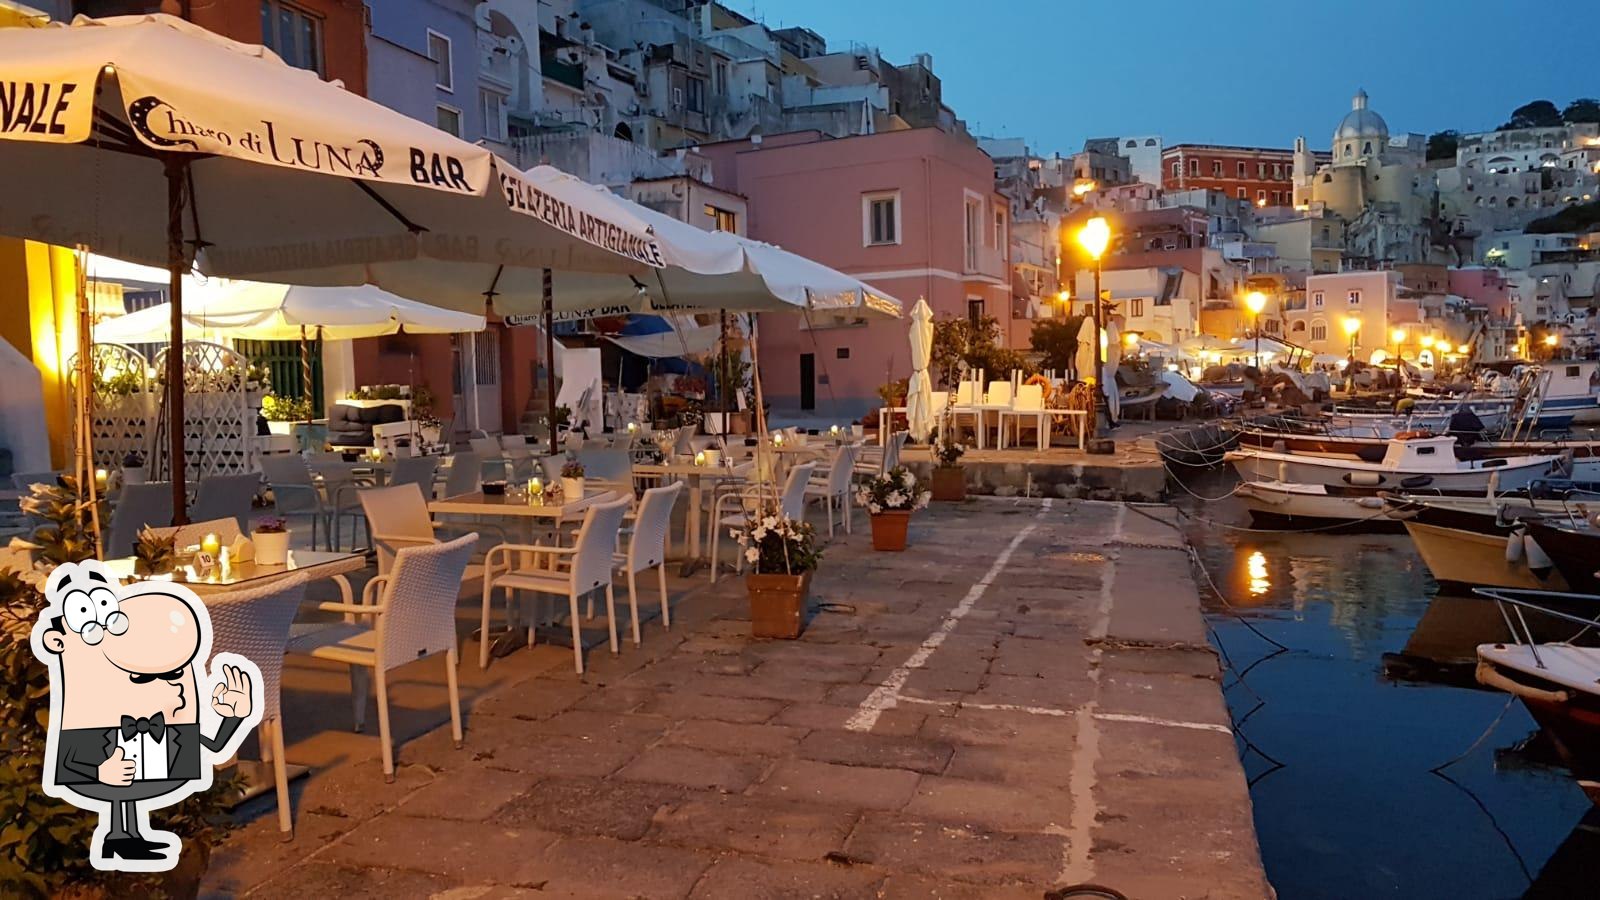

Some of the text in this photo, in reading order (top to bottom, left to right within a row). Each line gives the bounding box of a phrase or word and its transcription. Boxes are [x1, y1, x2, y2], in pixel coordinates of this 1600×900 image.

[129, 96, 476, 192] Chiaro di LUNA BAR
[580, 211, 664, 268] ARTIGIANALE
[201, 554, 211, 563] 10
